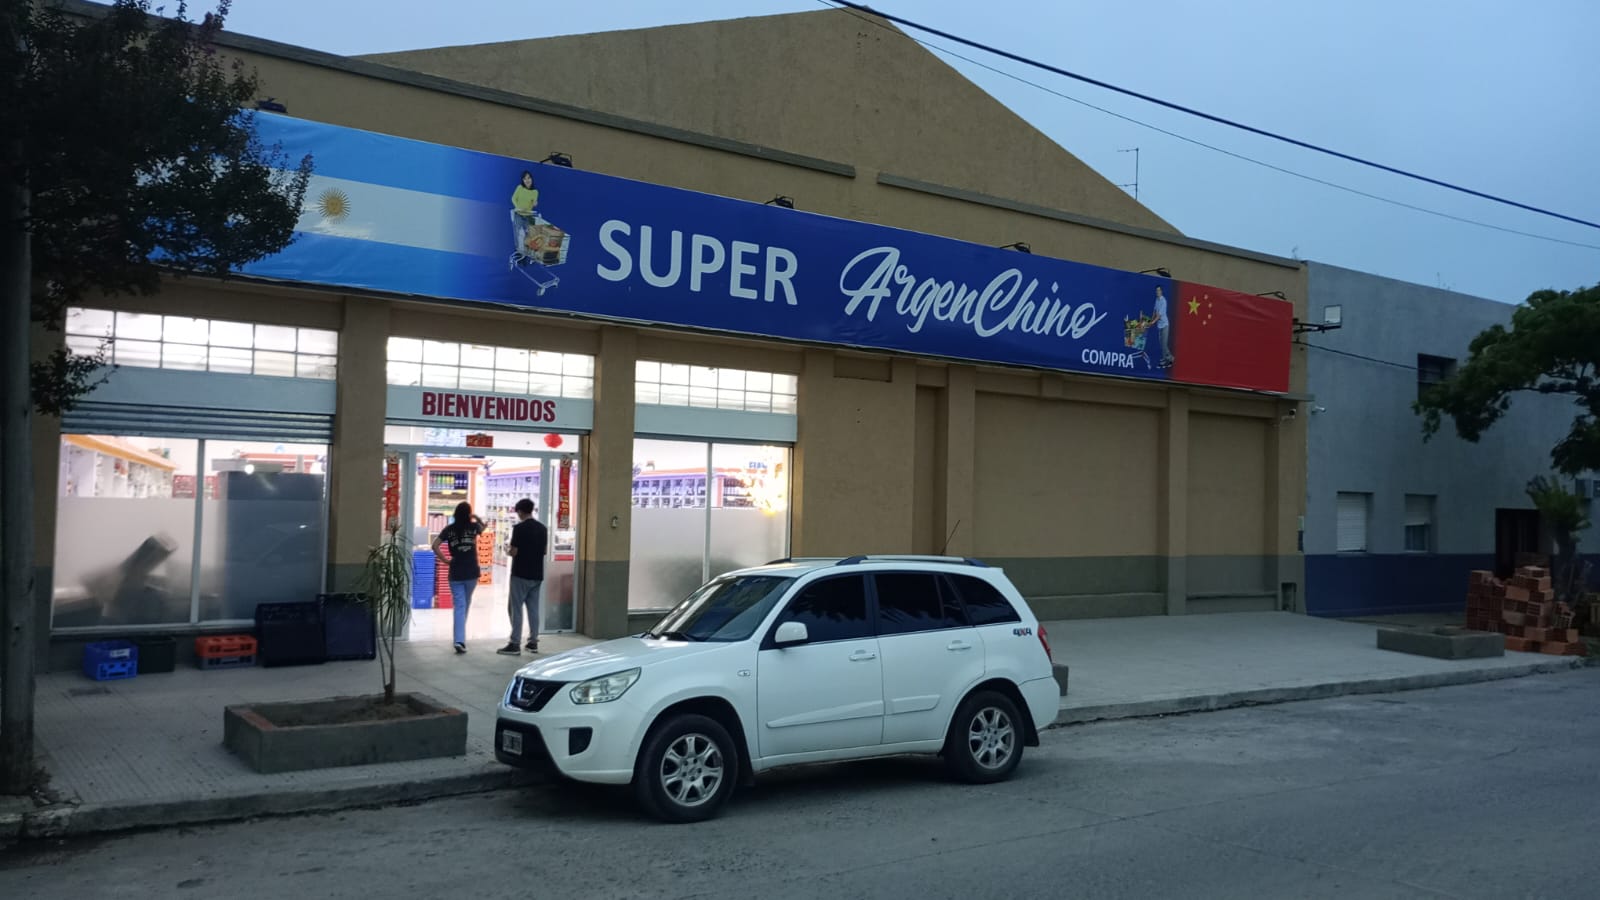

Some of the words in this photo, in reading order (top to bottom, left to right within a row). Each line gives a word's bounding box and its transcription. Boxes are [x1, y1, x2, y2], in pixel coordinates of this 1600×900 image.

[597, 219, 798, 305] SUPER
[839, 246, 1108, 339] ArgenChino
[1081, 348, 1135, 369] COMPRA
[422, 391, 556, 423] BIENVENIDOS
